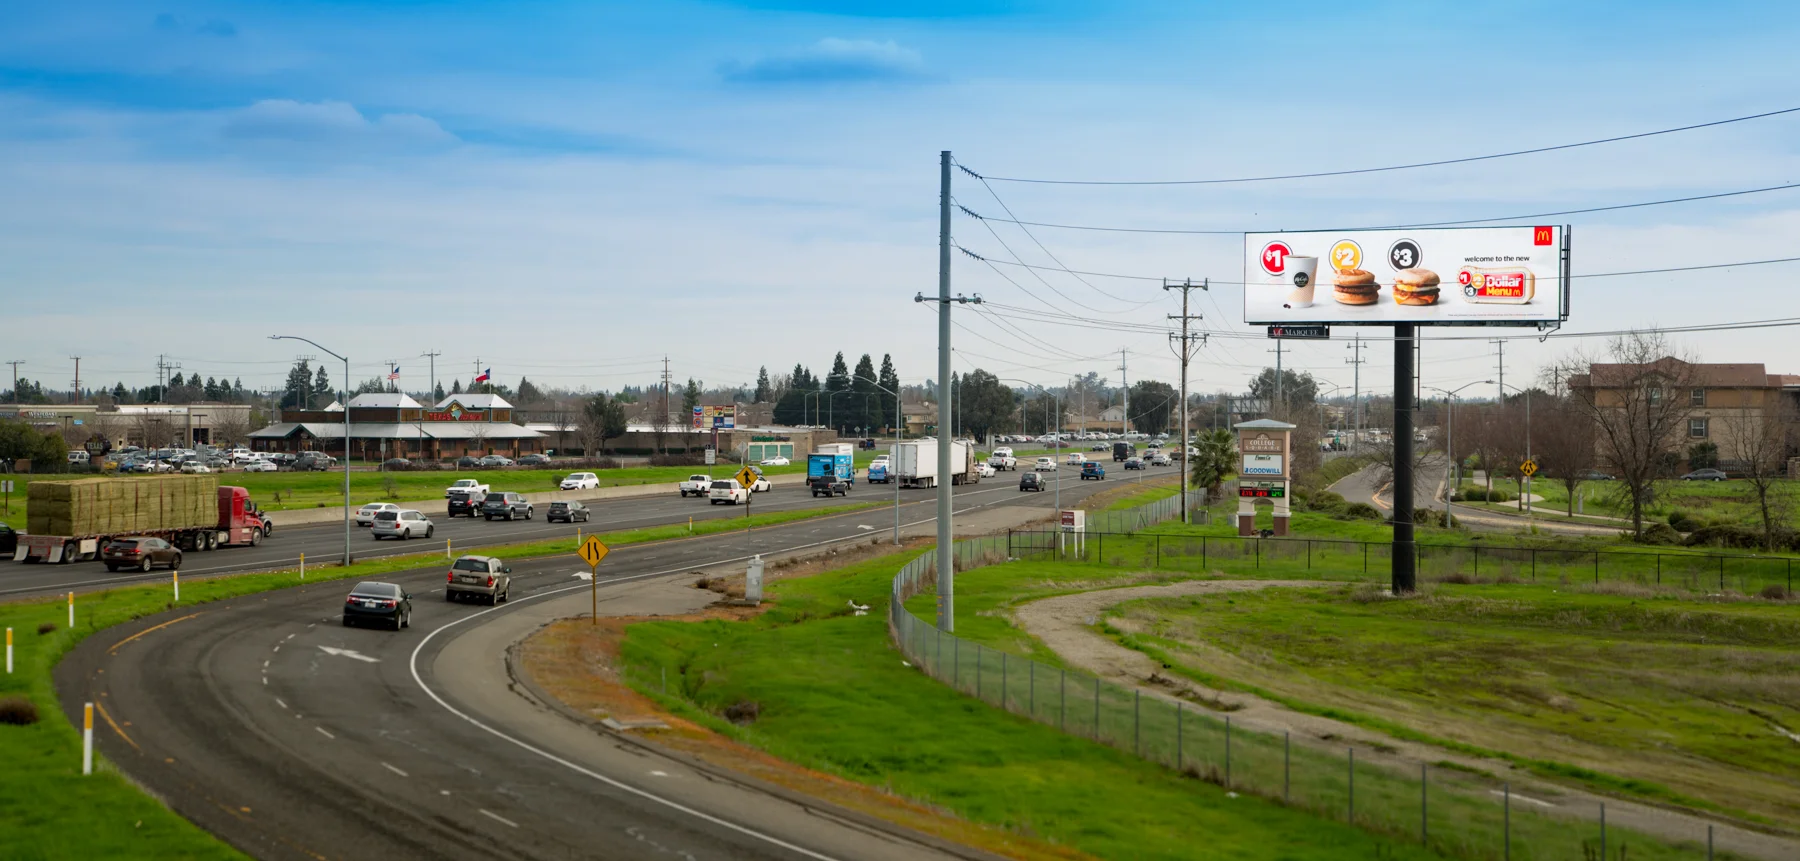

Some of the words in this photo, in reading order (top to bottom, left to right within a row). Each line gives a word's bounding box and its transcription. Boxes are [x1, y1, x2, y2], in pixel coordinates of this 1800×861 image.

[1266, 249, 1281, 267] $1
[1336, 248, 1354, 266] $2
[1394, 248, 1413, 267] $3
[1486, 275, 1522, 287] Dollar
[1486, 287, 1512, 296] Menu
